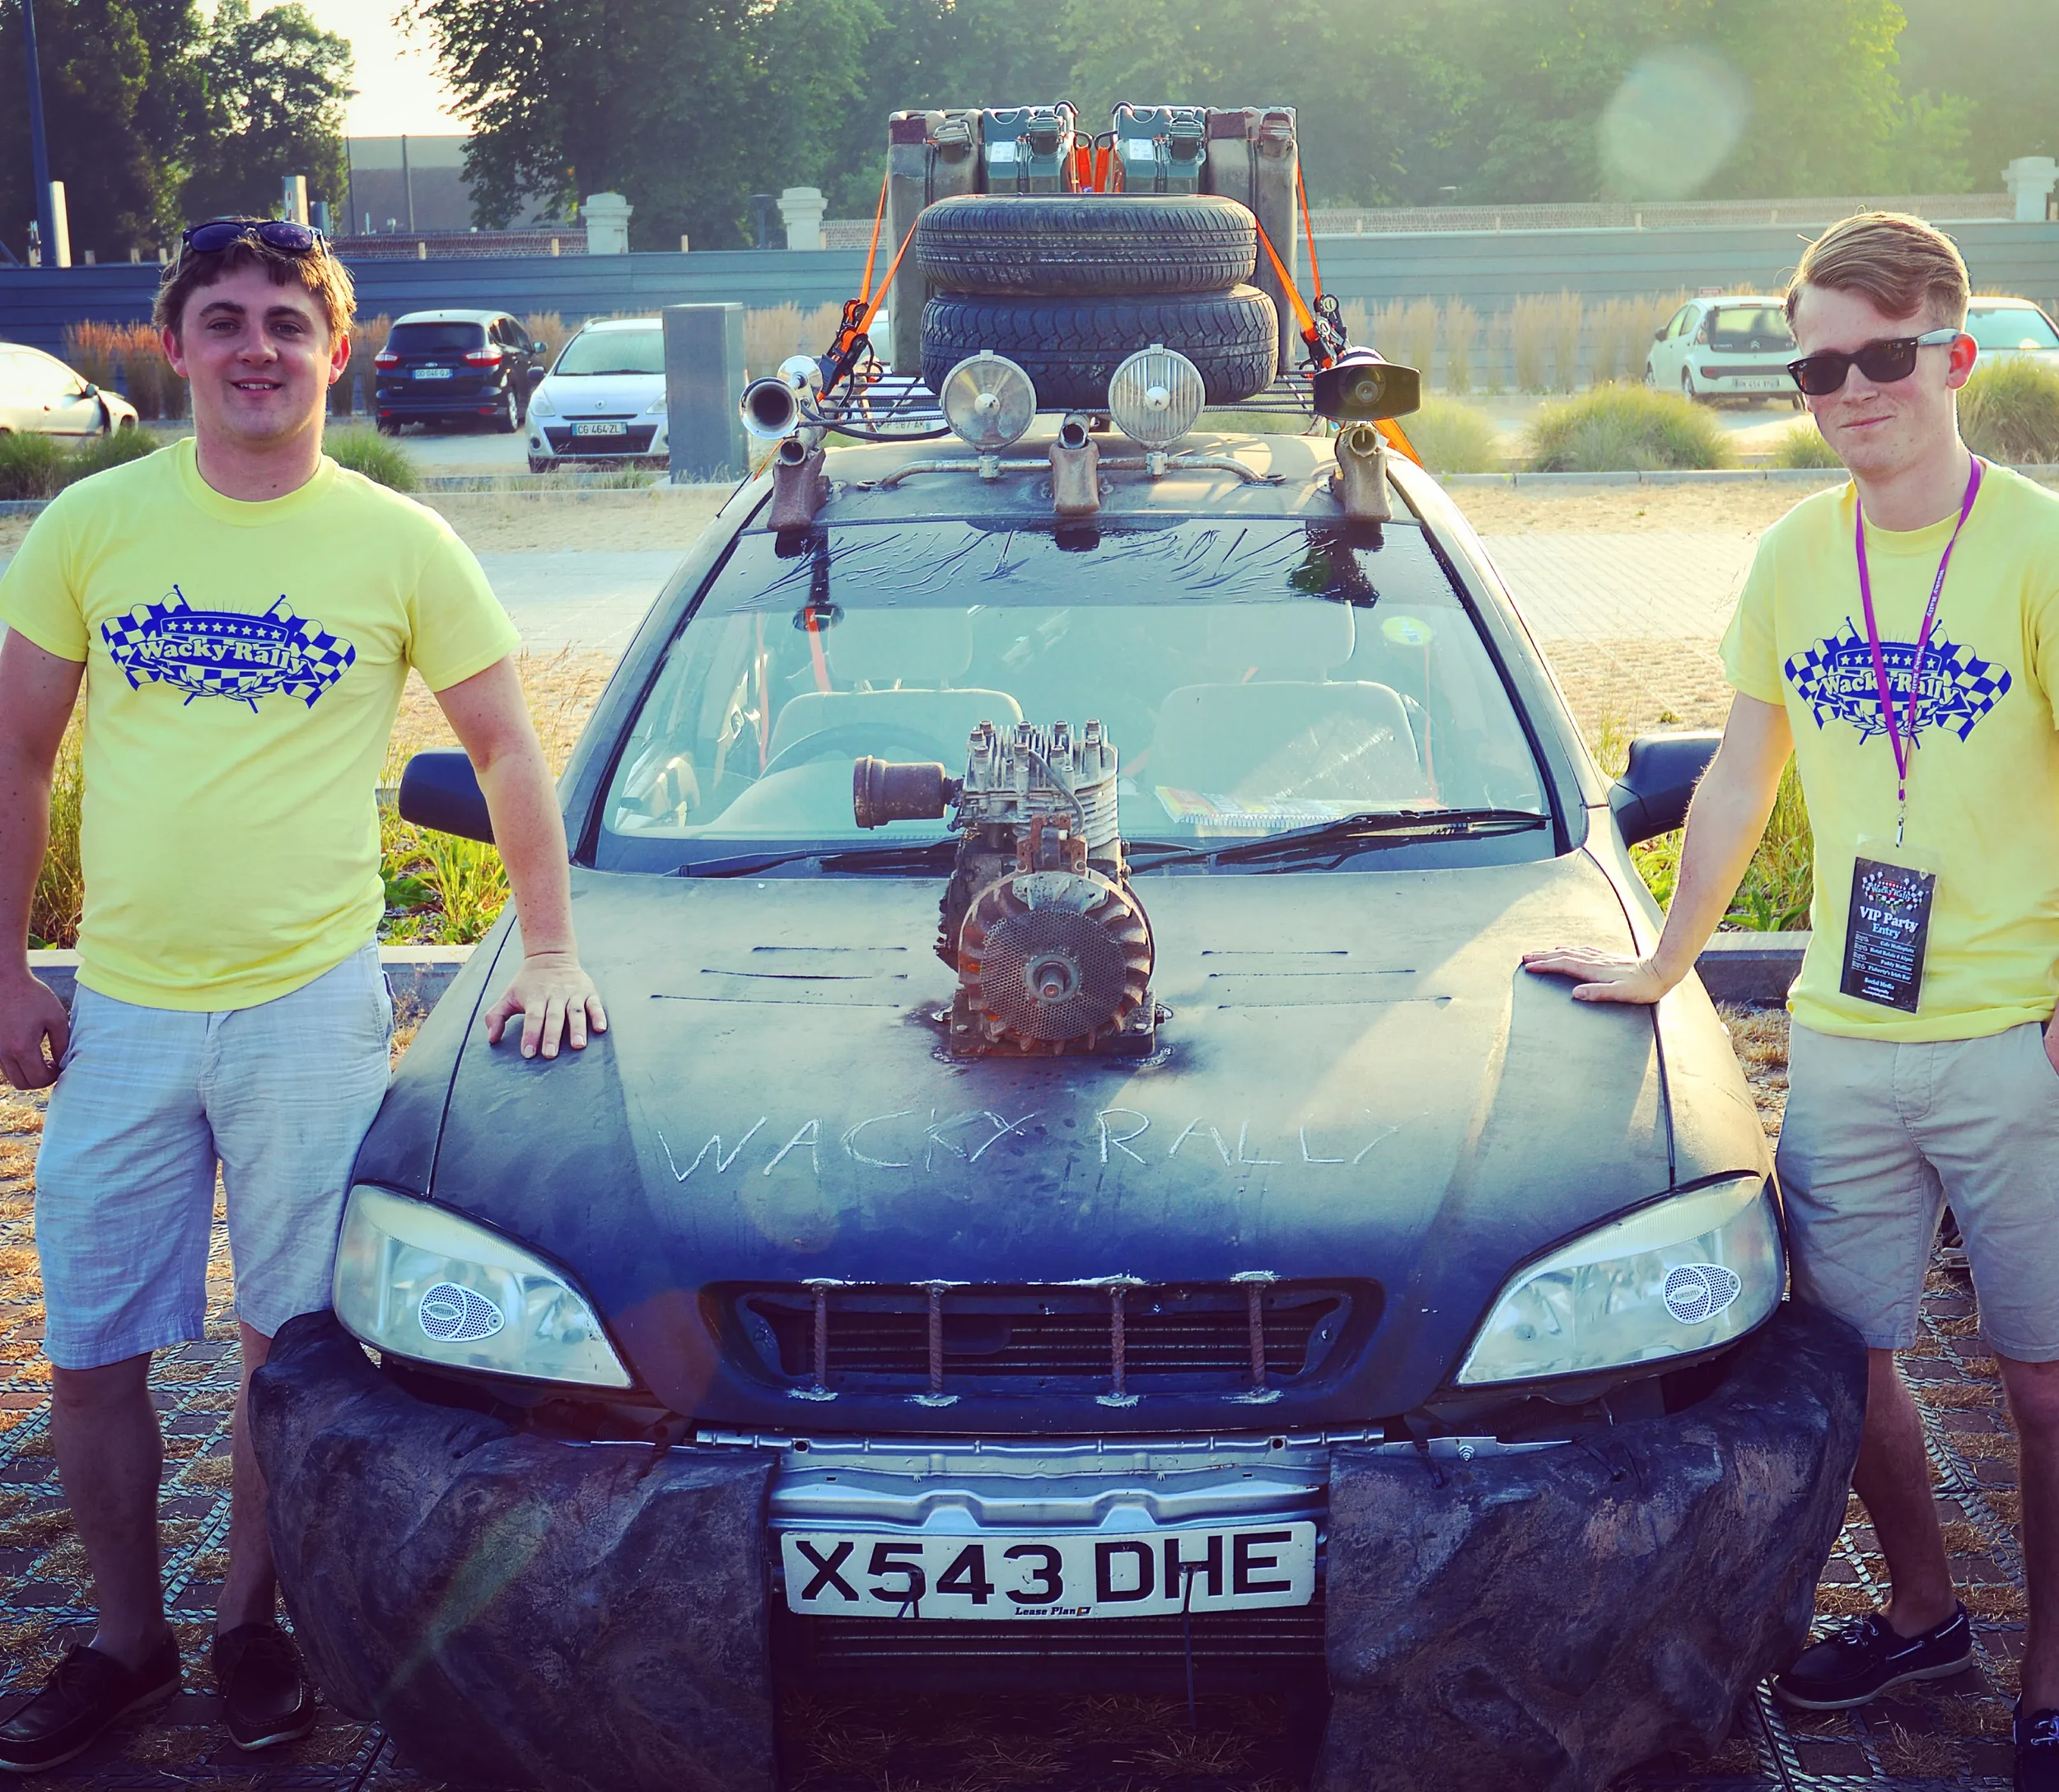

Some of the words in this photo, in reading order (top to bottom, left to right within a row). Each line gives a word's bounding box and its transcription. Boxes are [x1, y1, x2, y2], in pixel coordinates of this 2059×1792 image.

[1934, 569, 1945, 595] Wacky
[1926, 596, 1937, 618] Rally
[137, 638, 230, 661] Wacky
[233, 642, 307, 674] Rally
[1860, 906, 1882, 922] VIP
[1883, 912, 1919, 933] Party
[1872, 922, 1901, 940] Entry
[658, 1108, 1037, 1183] WACKY
[1098, 1108, 1431, 1167] RALLY
[796, 1539, 1064, 1605] X543
[1095, 1530, 1294, 1604] DHE
[1015, 1607, 1048, 1616] Lease
[1050, 1606, 1076, 1616] Plan
